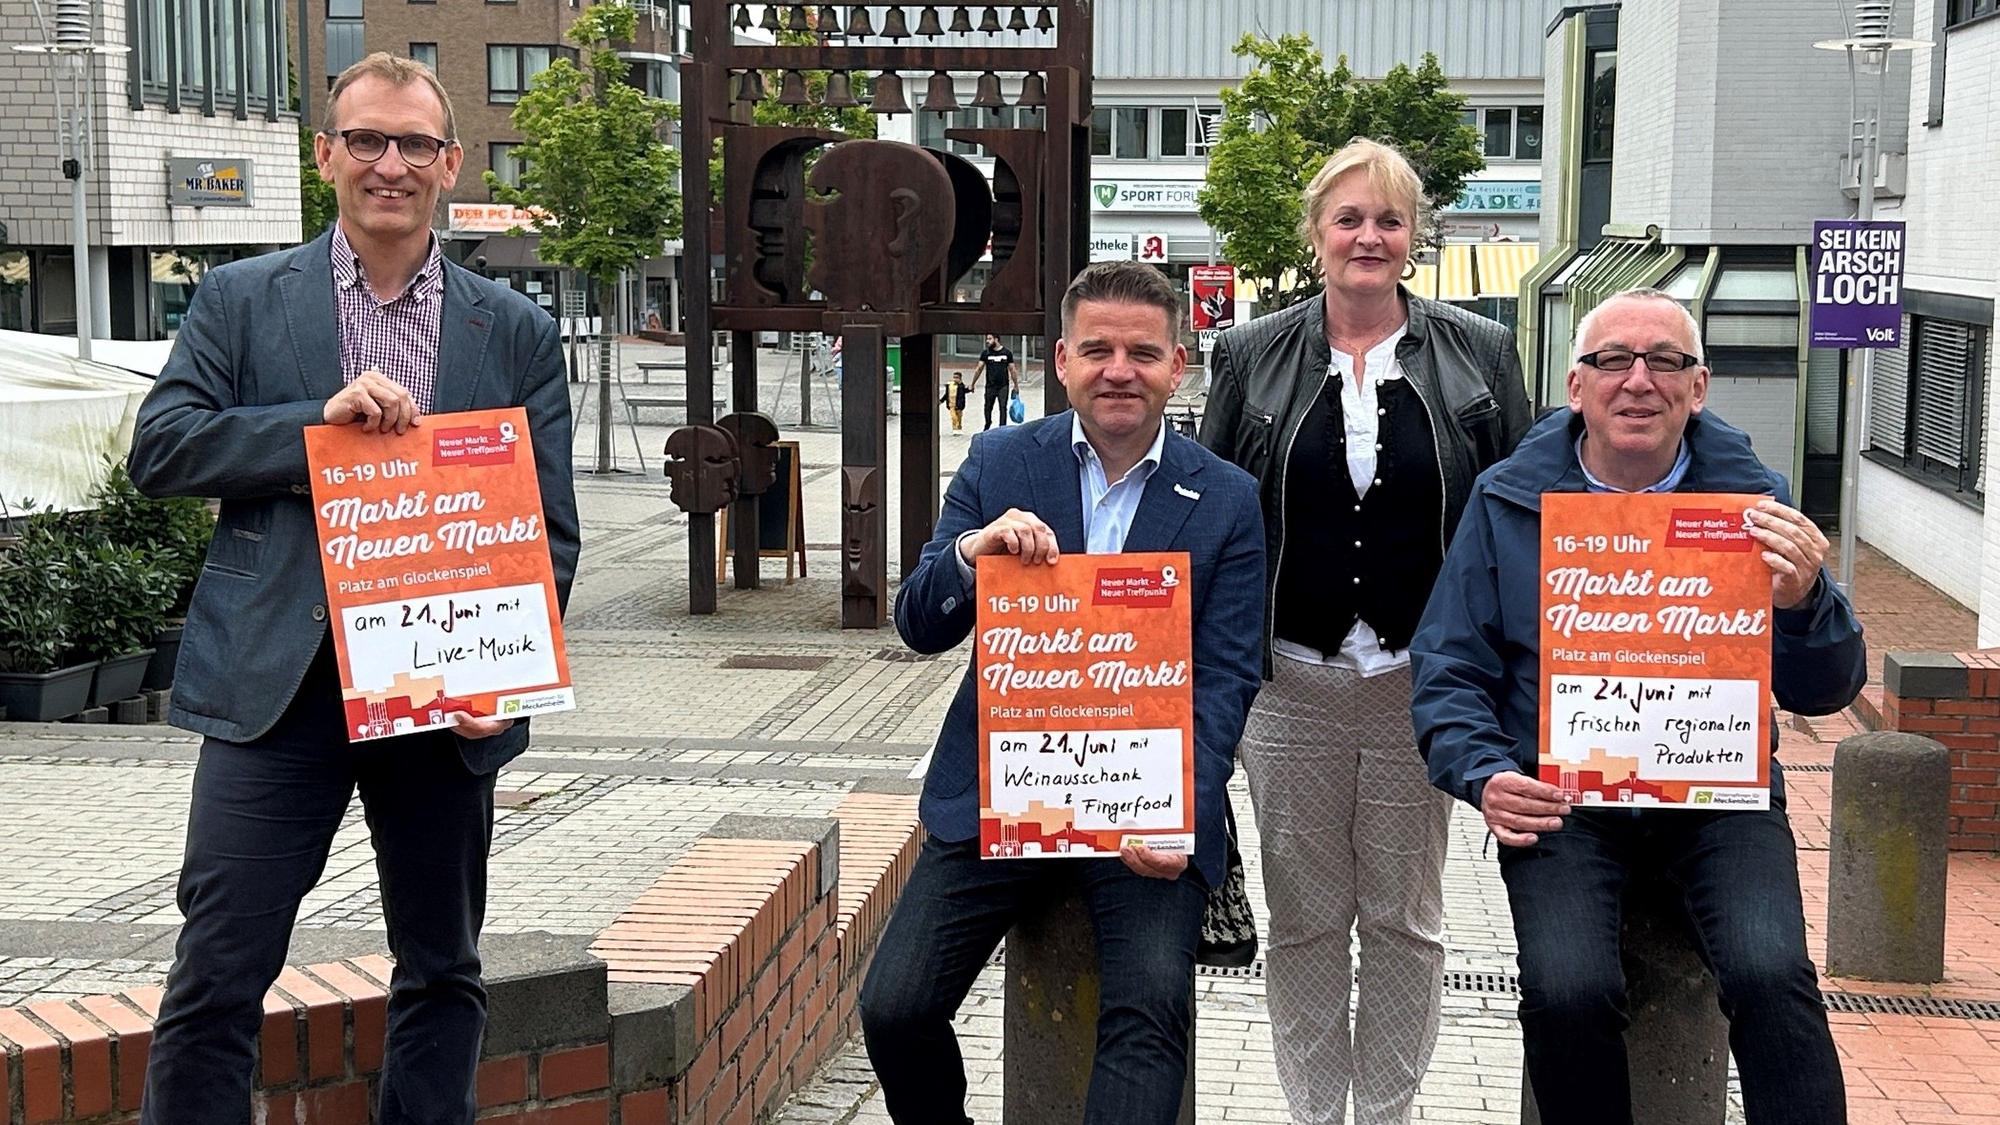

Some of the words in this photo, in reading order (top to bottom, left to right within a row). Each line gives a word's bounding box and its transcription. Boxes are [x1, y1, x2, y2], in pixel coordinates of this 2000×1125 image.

[207, 178, 245, 191] BAKER
[1120, 190, 1163, 202] SPORT
[1166, 190, 1198, 202] FORU
[454, 208, 482, 220] DER
[488, 208, 507, 220] PC
[1454, 194, 1522, 210] JADE
[1089, 239, 1128, 251] otheke
[1819, 229, 1852, 250] SEI
[1854, 229, 1901, 250] KEIN
[1818, 250, 1900, 275] ARSCH
[1816, 273, 1899, 305] LOCH
[1866, 327, 1895, 342] Volt
[321, 464, 376, 485] 16-19
[382, 458, 419, 480] Uhr
[321, 491, 430, 531] Markt
[434, 489, 486, 515] am
[1675, 519, 1702, 528] Neuer
[1703, 519, 1728, 528] Markt
[1675, 530, 1702, 540] Neuer
[1703, 530, 1748, 542] Treffpunkt
[326, 531, 434, 570] Neuen
[437, 513, 542, 554] Markt
[1553, 535, 1607, 553] 16-19
[1613, 535, 1651, 553] Uhr
[338, 577, 374, 594] Platz
[377, 575, 399, 590] am
[403, 562, 493, 587] Glockenspiel
[1546, 567, 1654, 602] Markt
[1658, 575, 1713, 597] am
[355, 614, 386, 632] am
[400, 603, 437, 629] 21.
[440, 600, 481, 633] Juni
[497, 598, 521, 612] mit
[988, 595, 1039, 614] 16-19
[1045, 594, 1080, 613] Uhr
[1546, 604, 1653, 639] Neuen
[1656, 606, 1767, 641] Markt
[413, 634, 537, 670] Live-Musik
[982, 627, 1085, 660] Markt
[1088, 631, 1138, 653] am
[1552, 648, 1586, 662] Platz
[1590, 651, 1612, 662] am
[1615, 649, 1706, 667] Glockenspiel
[983, 663, 1085, 696] Neuen
[1087, 660, 1188, 694] Markt
[1556, 682, 1582, 695] am
[1594, 678, 1627, 701] 21.
[1630, 682, 1674, 714] Juni
[1688, 687, 1712, 700] mit
[990, 705, 1022, 718] Platz
[1025, 707, 1046, 718] am
[1049, 704, 1134, 720] Glockenspiel
[1567, 711, 1641, 737] frischen
[1664, 715, 1751, 745] regionalen
[1000, 739, 1027, 753] am
[1038, 732, 1073, 754] 21.
[1074, 732, 1116, 767] Juni
[1130, 737, 1149, 750] mit
[1654, 742, 1744, 765] Produkten
[1004, 763, 1142, 788] Weinausschank
[1081, 794, 1172, 823] Fingerfood
